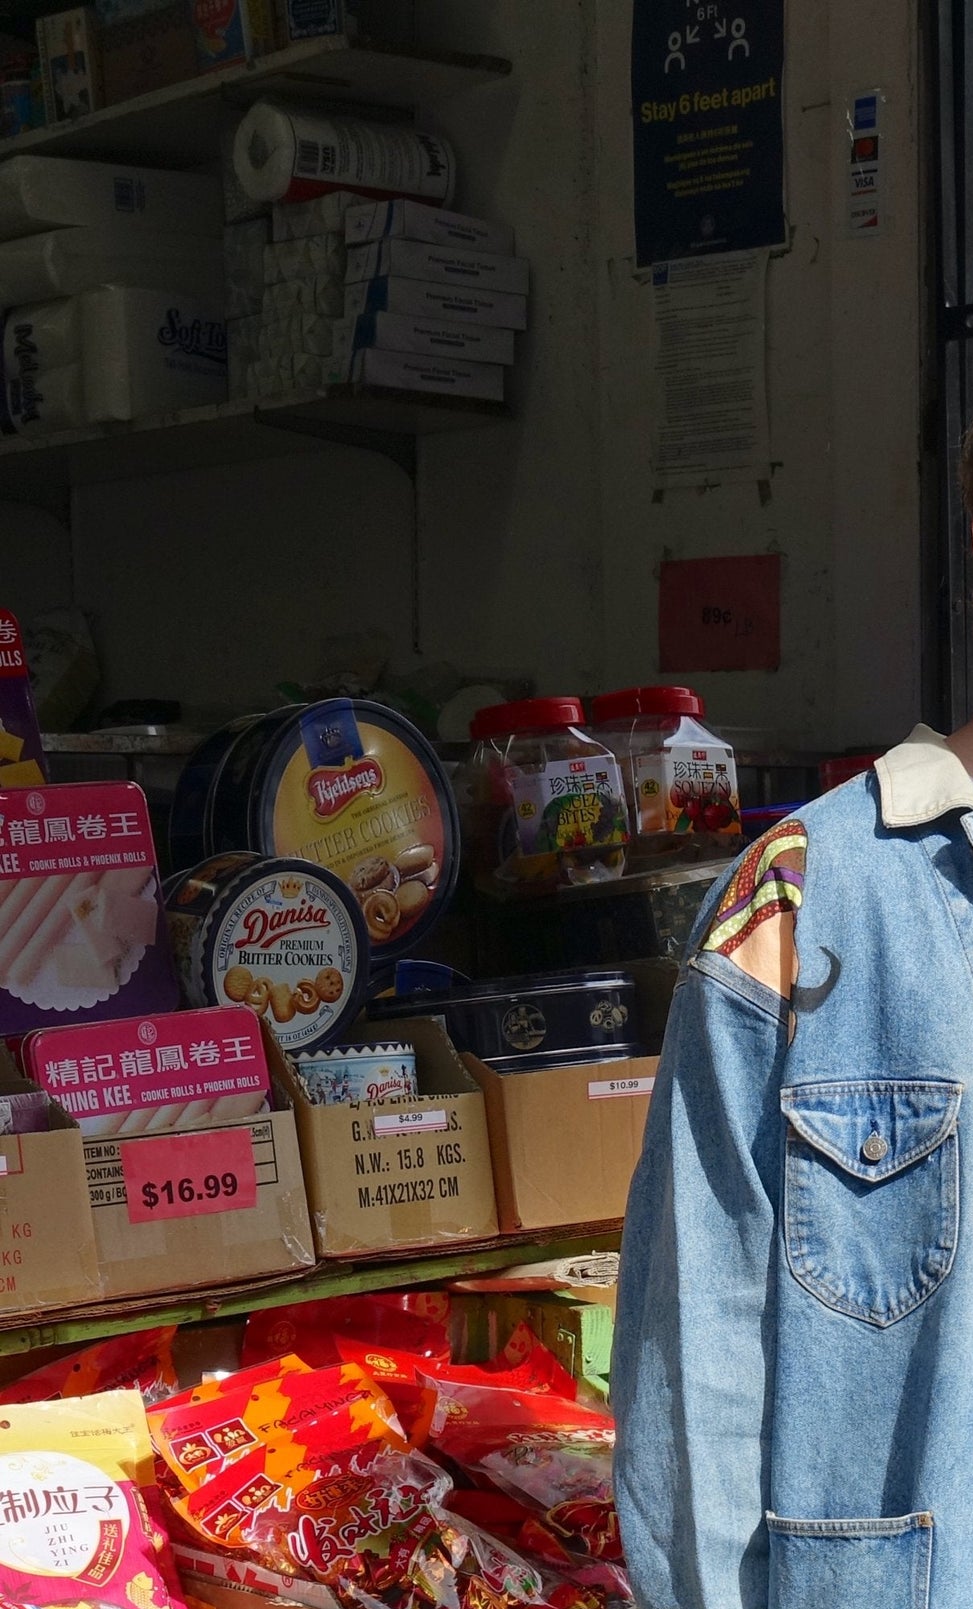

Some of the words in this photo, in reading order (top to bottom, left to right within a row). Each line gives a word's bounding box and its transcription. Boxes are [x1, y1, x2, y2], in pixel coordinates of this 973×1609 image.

[697, 7, 705, 21] 6
[707, 5, 718, 19] Ft
[640, 100, 676, 124] Stay
[679, 94, 692, 115] 6
[693, 87, 729, 113] feet
[731, 76, 776, 108] apart
[854, 176, 874, 188] VISA
[0, 650, 23, 667] LLS
[314, 767, 378, 809] Kjeldsens
[0, 811, 142, 847] 龍鳳卷王
[29, 859, 57, 871] COOKIE
[58, 857, 82, 869] ROLLS
[83, 856, 89, 866] &
[90, 853, 122, 865] PHOENIX
[123, 851, 146, 863] ROLLS
[235, 900, 331, 948] Danisa
[280, 940, 324, 951] PREMIUM
[238, 951, 282, 966] BUTTER
[284, 951, 333, 966] COOKIES
[45, 1036, 256, 1088] 精記龍鳳卷王
[141, 1089, 169, 1103] COOKIE
[171, 1085, 195, 1099] ROLLS
[196, 1084, 202, 1095] &
[203, 1079, 235, 1094] PHOENIX
[237, 1076, 261, 1089] ROLLS
[609, 1081, 639, 1090] $10.99
[103, 1084, 133, 1109] KEE
[399, 1113, 423, 1123] $4.99
[83, 1147, 103, 1160] ITEM
[104, 1145, 115, 1157] NO
[396, 1147, 424, 1170] 15.8
[437, 1143, 466, 1165] KGS.
[142, 1172, 238, 1209] $16.99
[358, 1178, 434, 1209] M:41X21X32
[439, 1176, 459, 1197] CM
[12, 1223, 32, 1239] KG
[2, 1250, 22, 1265] KG
[0, 1486, 119, 1526] 制应子
[44, 1523, 69, 1535] JIU
[48, 1534, 74, 1546] ZHI
[51, 1544, 89, 1557] YING
[55, 1559, 69, 1567] ZI
